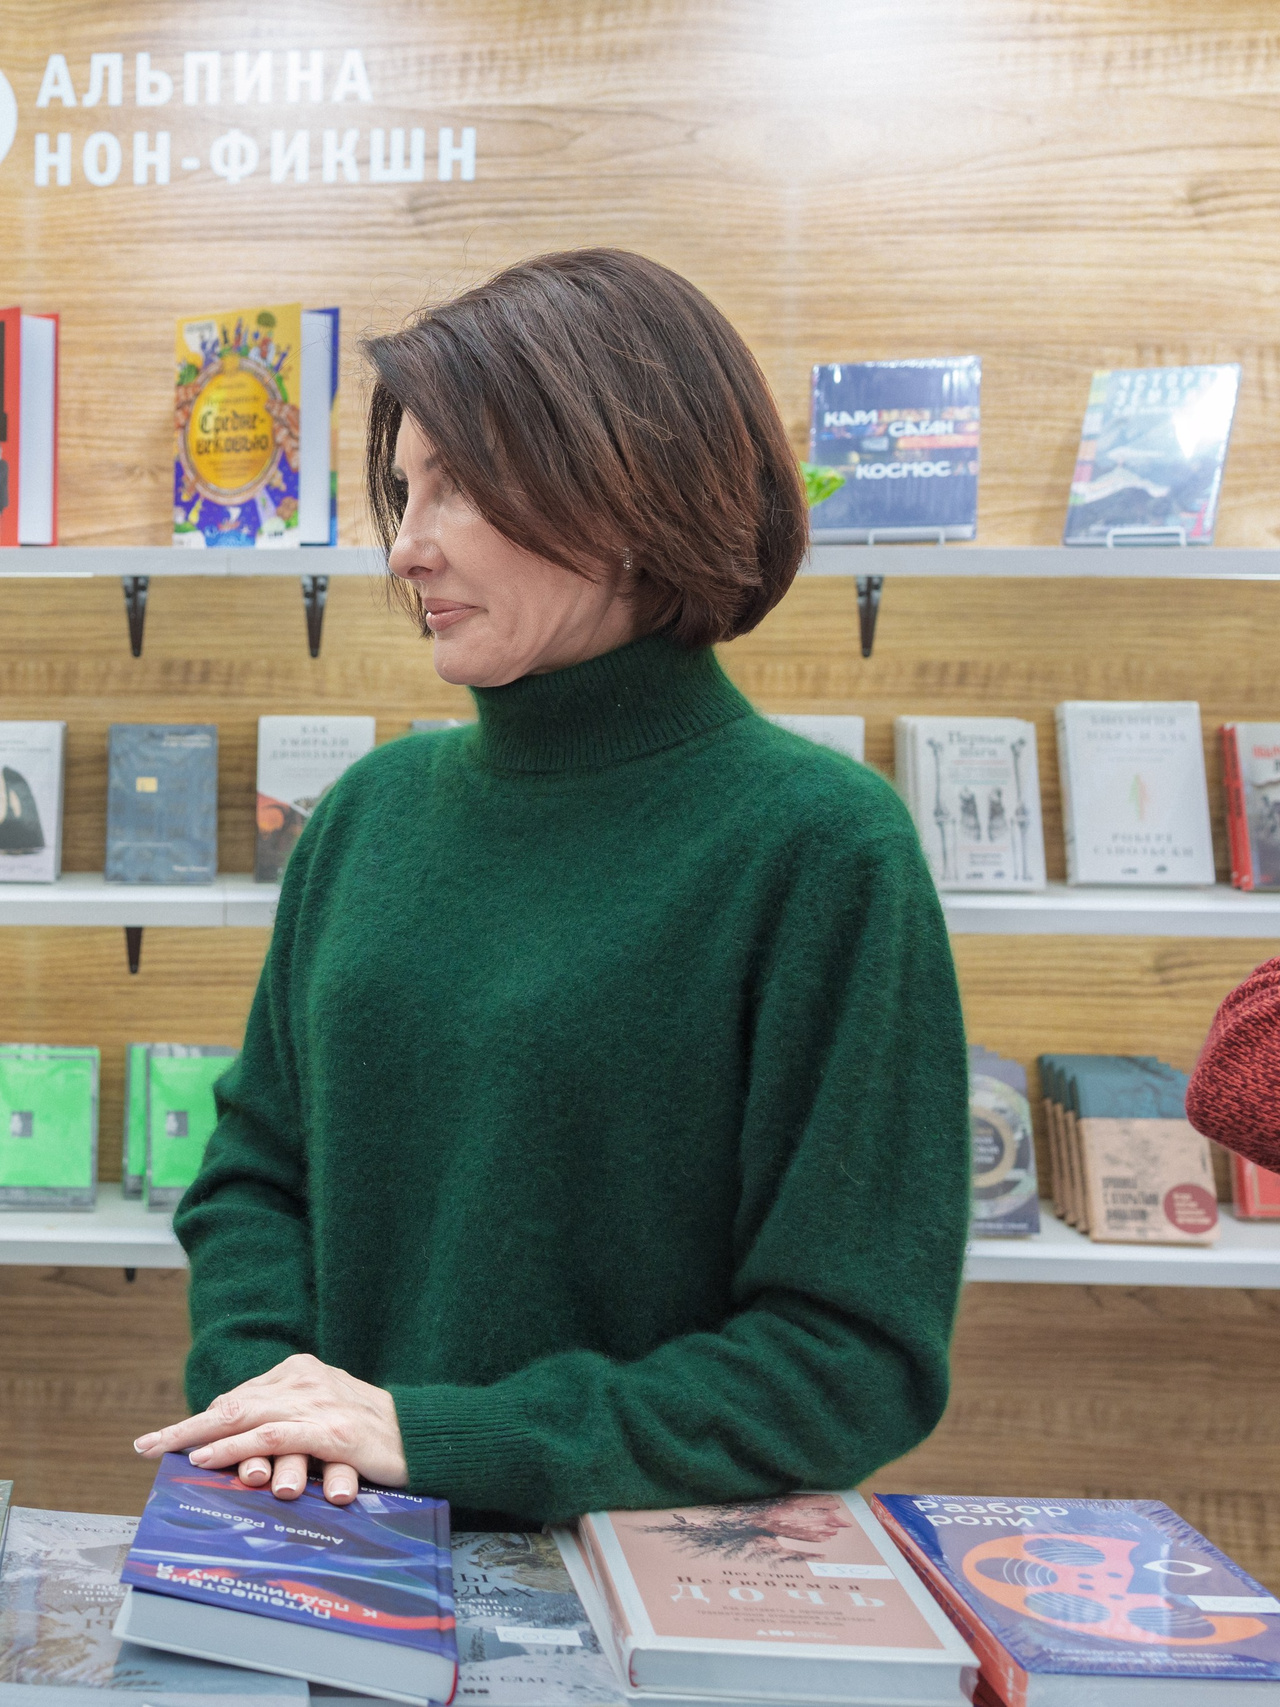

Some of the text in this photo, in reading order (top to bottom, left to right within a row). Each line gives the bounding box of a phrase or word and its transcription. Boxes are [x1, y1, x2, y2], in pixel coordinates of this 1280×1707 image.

[35, 50, 373, 108] АЛЬПИНА
[34, 128, 477, 187] НОН-ФИКШН
[888, 420, 954, 437] САГАН
[855, 460, 952, 480] КОСМОС
[360, 1486, 423, 1504] Практика
[912, 1499, 1069, 1517] Разбор
[179, 1503, 344, 1545] Андрей Россохин
[925, 1513, 1035, 1528] роли
[187, 1568, 350, 1612] подлинному
[454, 1585, 534, 1598] ДАХ
[676, 1576, 861, 1591] Нелюбимая
[155, 1570, 331, 1620] Путешествие
[670, 1584, 886, 1607] ДОЧЬ
[456, 1604, 523, 1612] ЛЬШОГО
